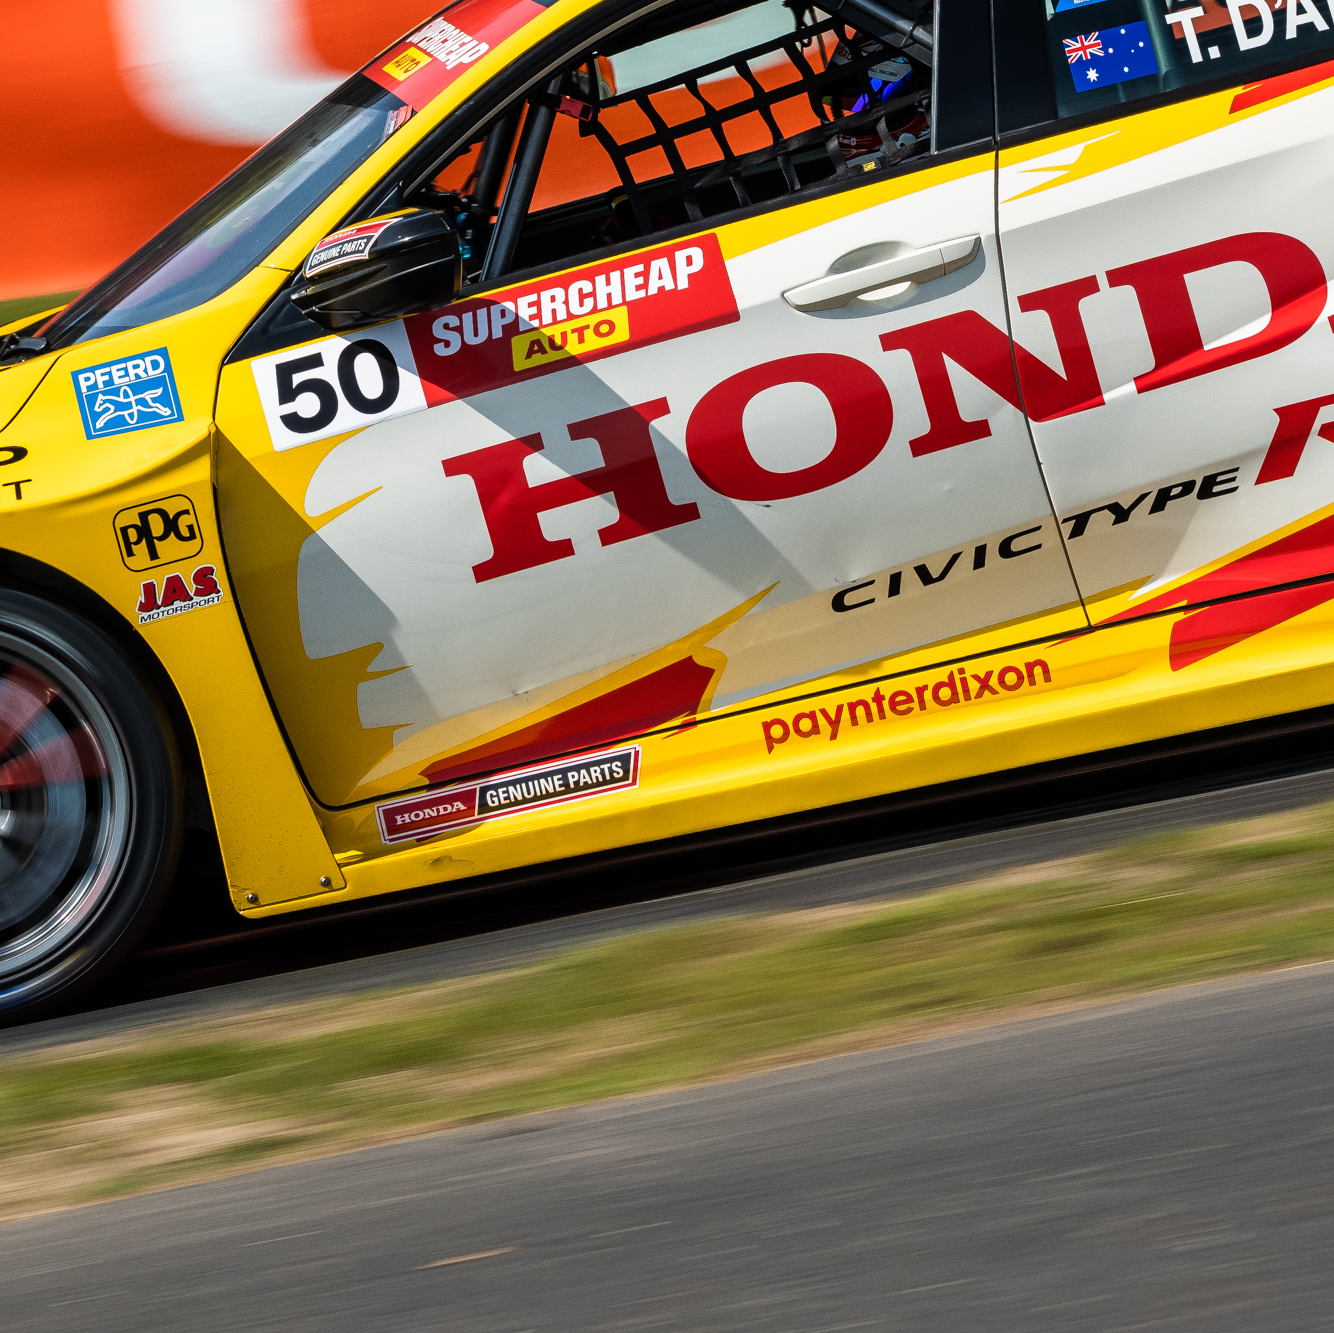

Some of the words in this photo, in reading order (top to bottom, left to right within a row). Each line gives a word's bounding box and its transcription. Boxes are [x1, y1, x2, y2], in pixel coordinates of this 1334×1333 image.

[390, 52, 423, 75] AUTO
[1165, 6, 1222, 65] T.
[311, 244, 343, 267] GENUINE
[340, 238, 368, 255] PARTS
[432, 245, 705, 357] SUPERCHEAP
[524, 318, 617, 360] AUTO
[78, 354, 165, 394] PFERD
[275, 340, 400, 435] 50
[119, 507, 197, 562] PPG
[831, 524, 1044, 614] CIVIC
[1061, 466, 1241, 541] TYPE
[140, 594, 223, 624] MOTORSPORT
[761, 658, 1052, 755] paynterdixon
[395, 801, 467, 826] HONDA
[486, 773, 565, 807] GENUINE
[567, 761, 624, 789] PARTS
